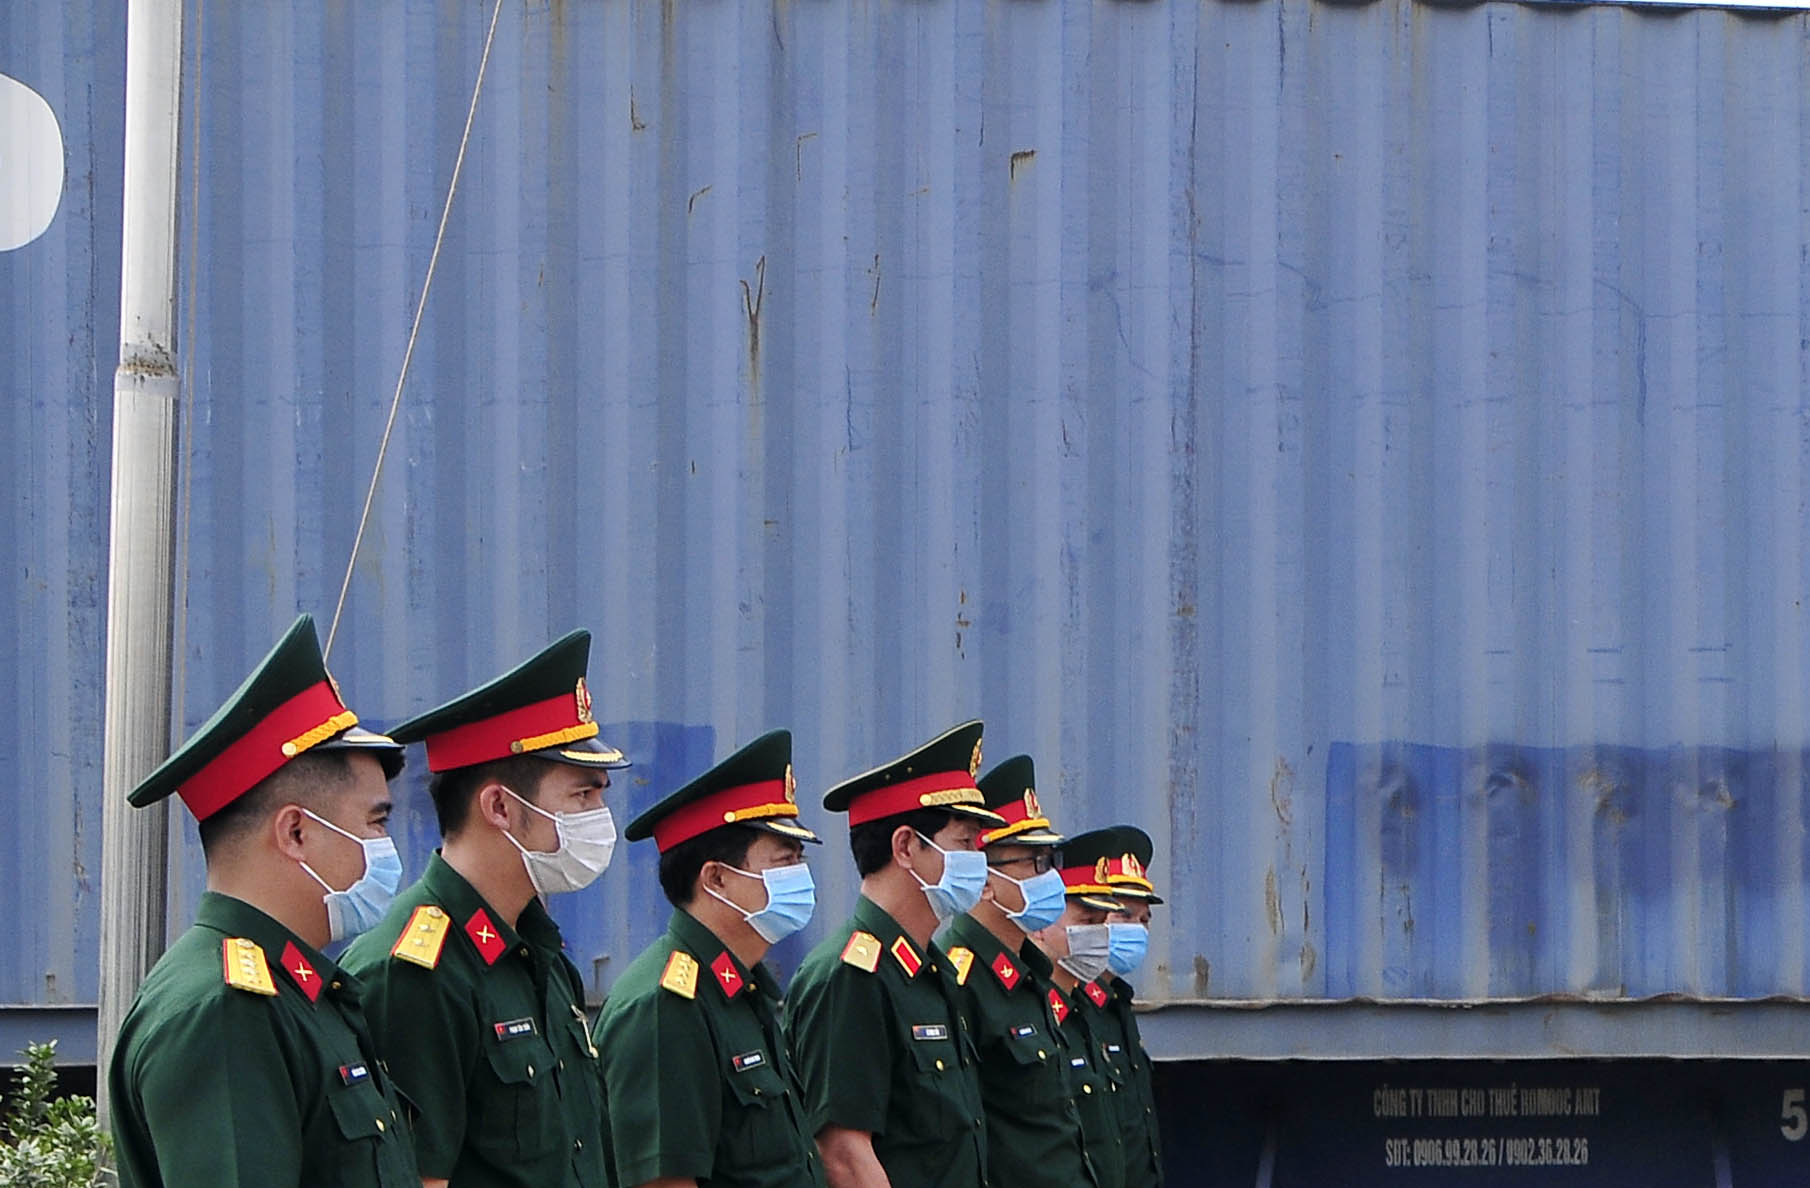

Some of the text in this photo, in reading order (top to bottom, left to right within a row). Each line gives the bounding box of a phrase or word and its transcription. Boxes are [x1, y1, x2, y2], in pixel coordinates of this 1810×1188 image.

[1373, 1084, 1408, 1117] CÔNG
[1409, 1088, 1423, 1116] TY
[1426, 1088, 1458, 1117] TNHH
[1460, 1088, 1486, 1116] CHO
[1413, 1138, 1497, 1167] 0906.99.28.26
